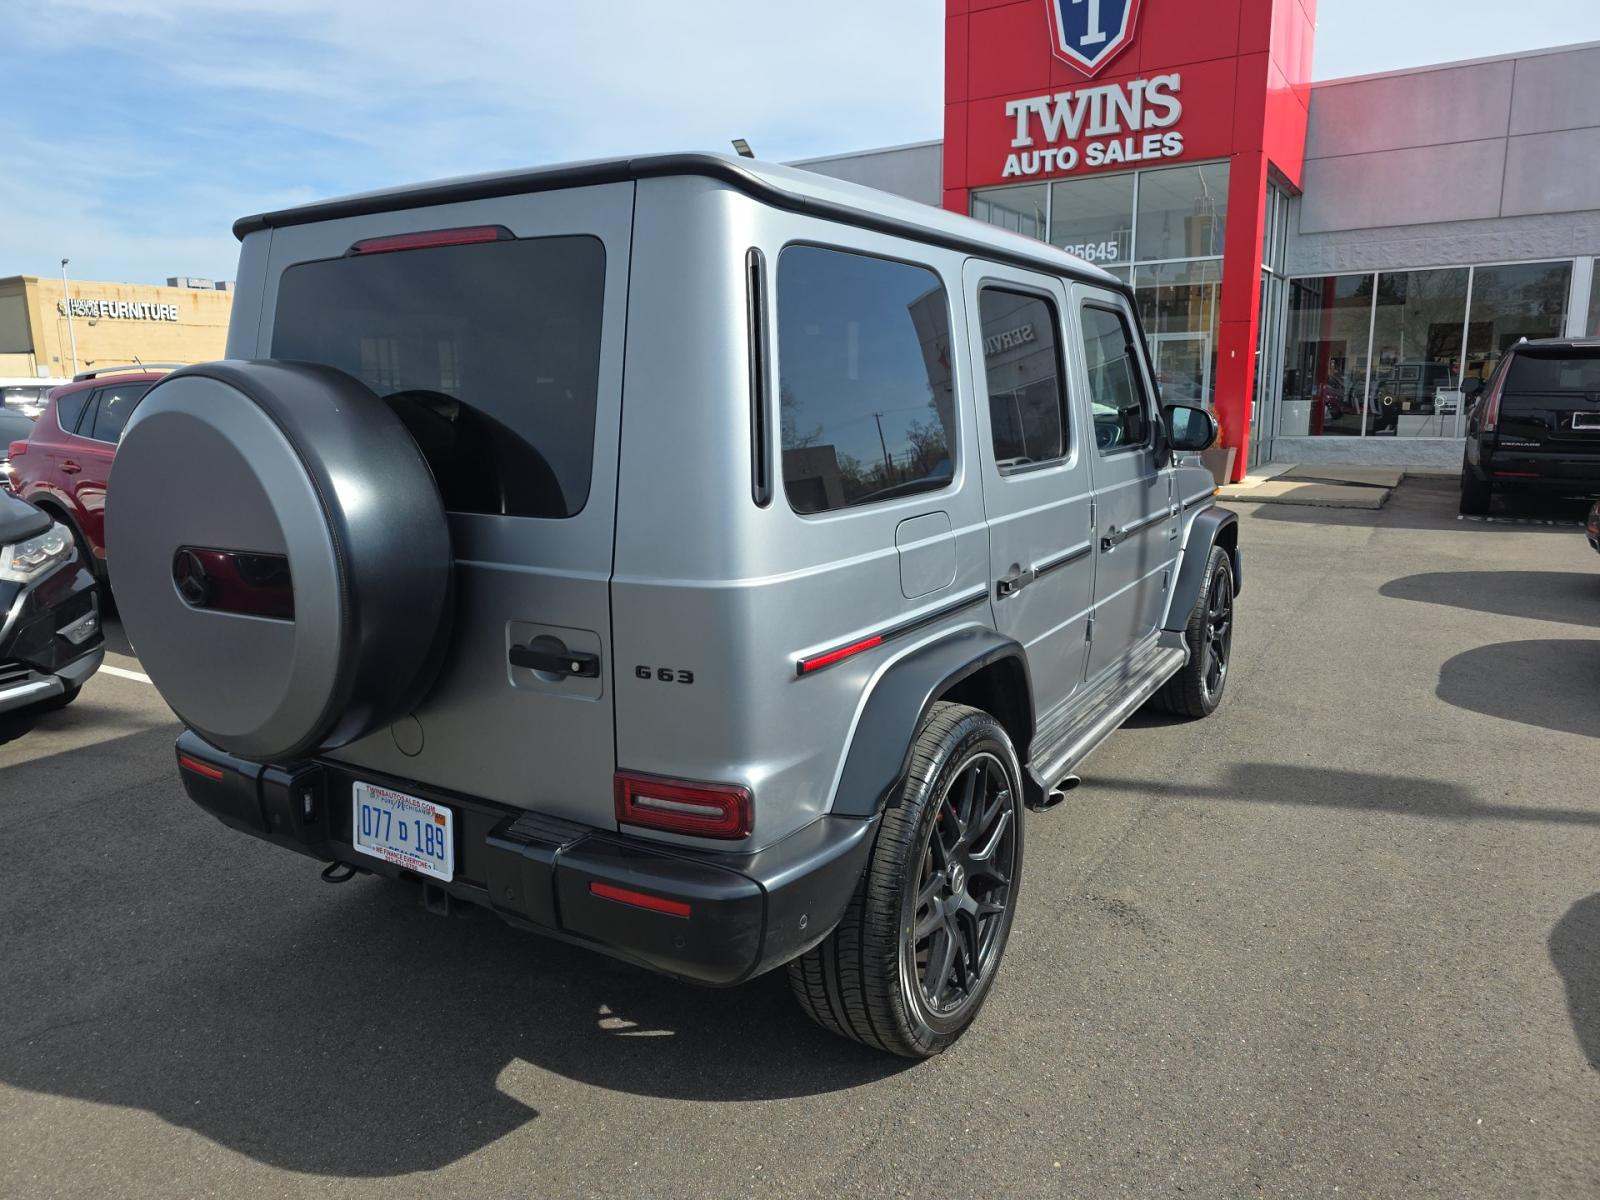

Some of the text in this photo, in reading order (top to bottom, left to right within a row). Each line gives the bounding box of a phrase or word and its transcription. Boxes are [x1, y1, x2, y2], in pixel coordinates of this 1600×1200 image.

[1006, 73, 1183, 148] TWINS
[1002, 131, 1184, 178] AUTO SALES
[99, 300, 179, 321] FURNITURE
[362, 804, 391, 842] 077
[415, 820, 444, 860] 189
